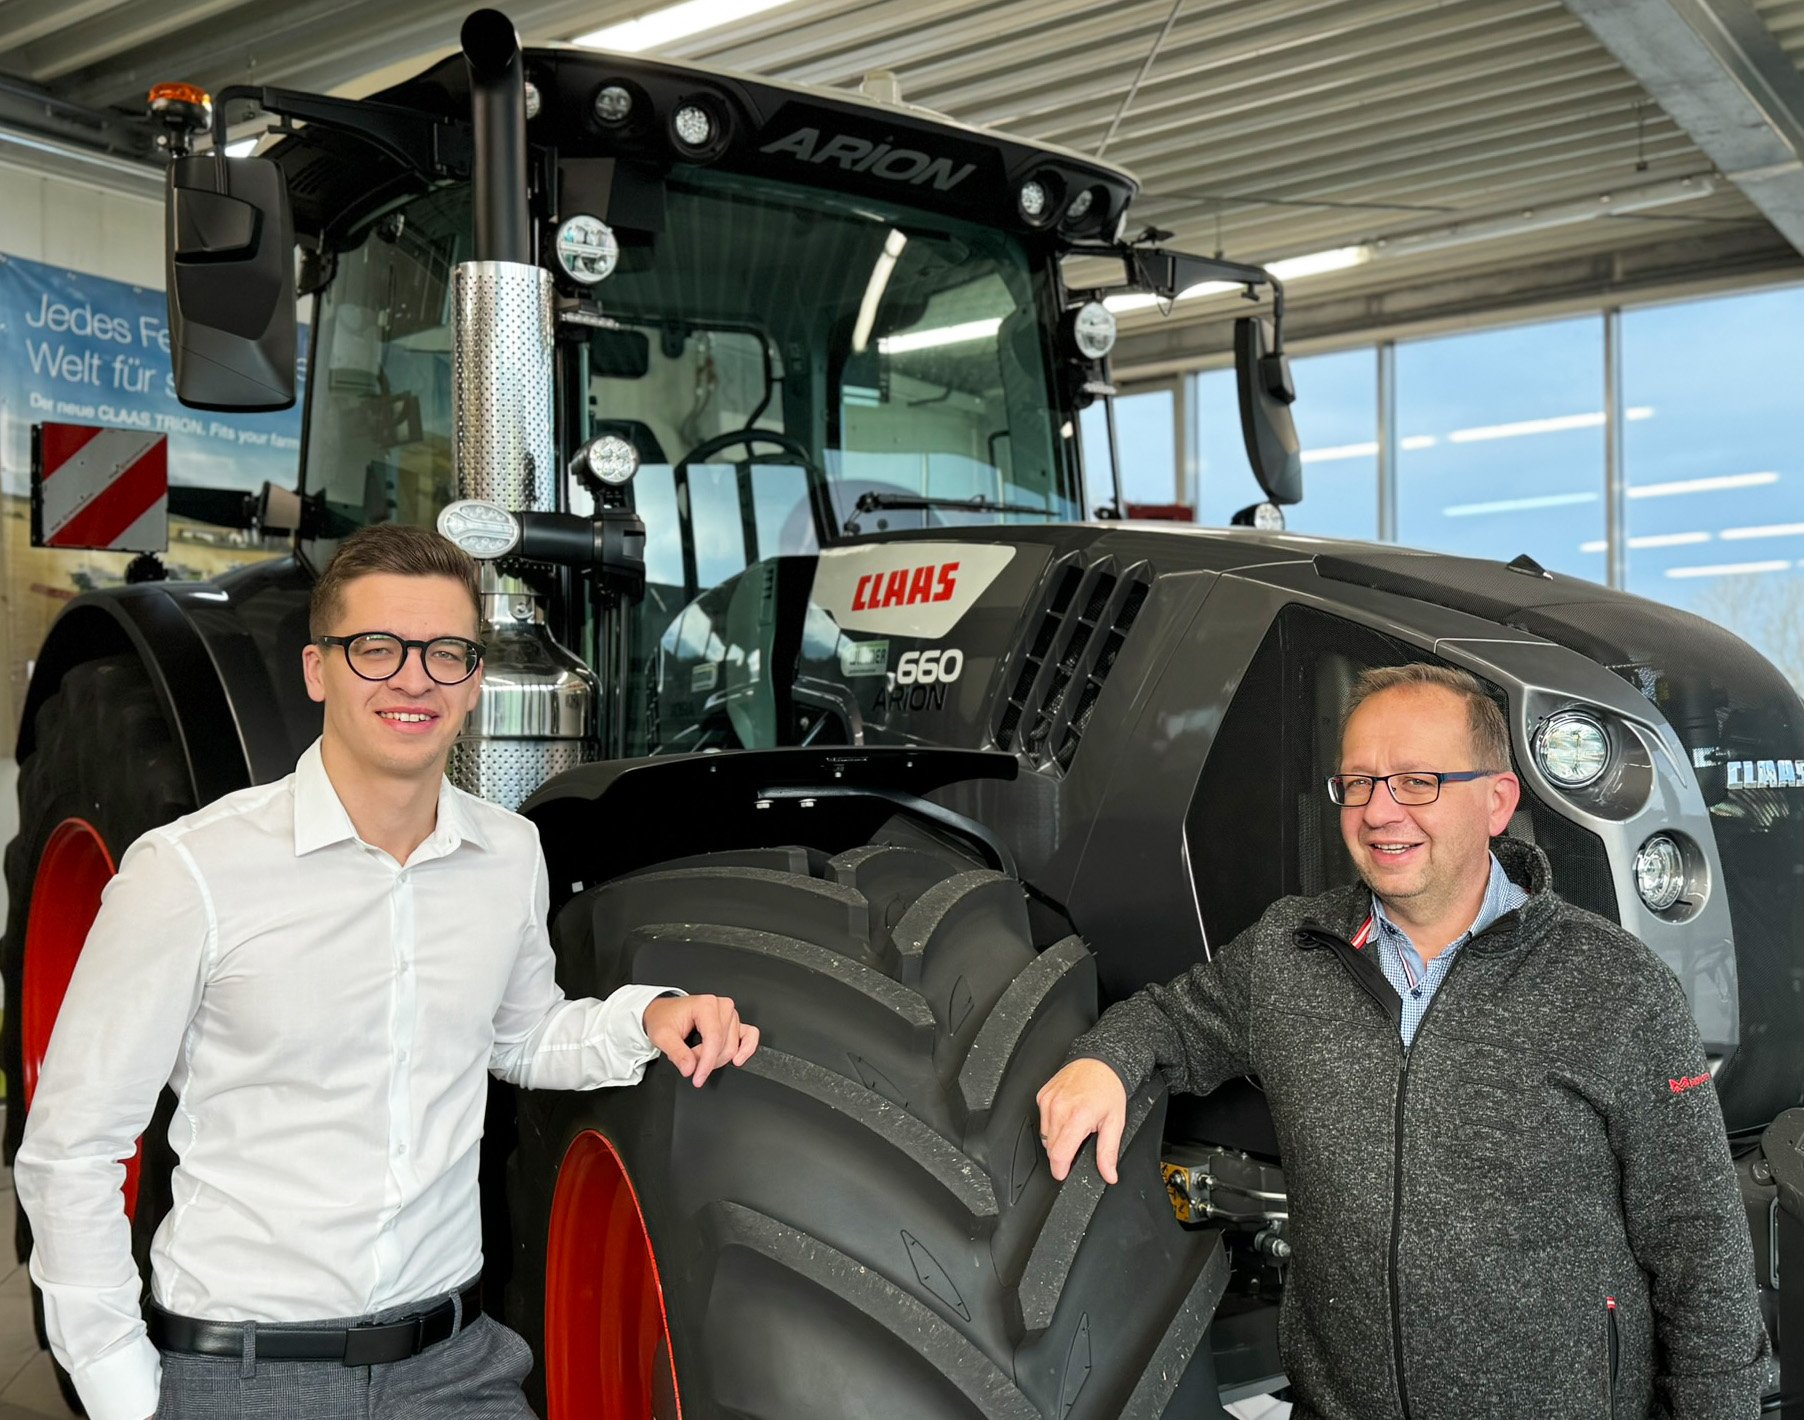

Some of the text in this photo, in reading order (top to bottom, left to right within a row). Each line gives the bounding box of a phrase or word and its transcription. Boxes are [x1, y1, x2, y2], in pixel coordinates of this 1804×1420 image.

[759, 127, 977, 191] ARION
[26, 294, 132, 345] Jedes
[25, 338, 102, 387] Welt
[113, 354, 157, 393] für
[30, 392, 54, 411] Der
[56, 400, 95, 419] neue
[98, 404, 151, 426] CLAAS
[209, 422, 236, 441] Fits
[237, 429, 269, 446] your
[851, 561, 961, 612] CLAAS
[896, 648, 965, 685] 660
[872, 684, 948, 712] ARION
